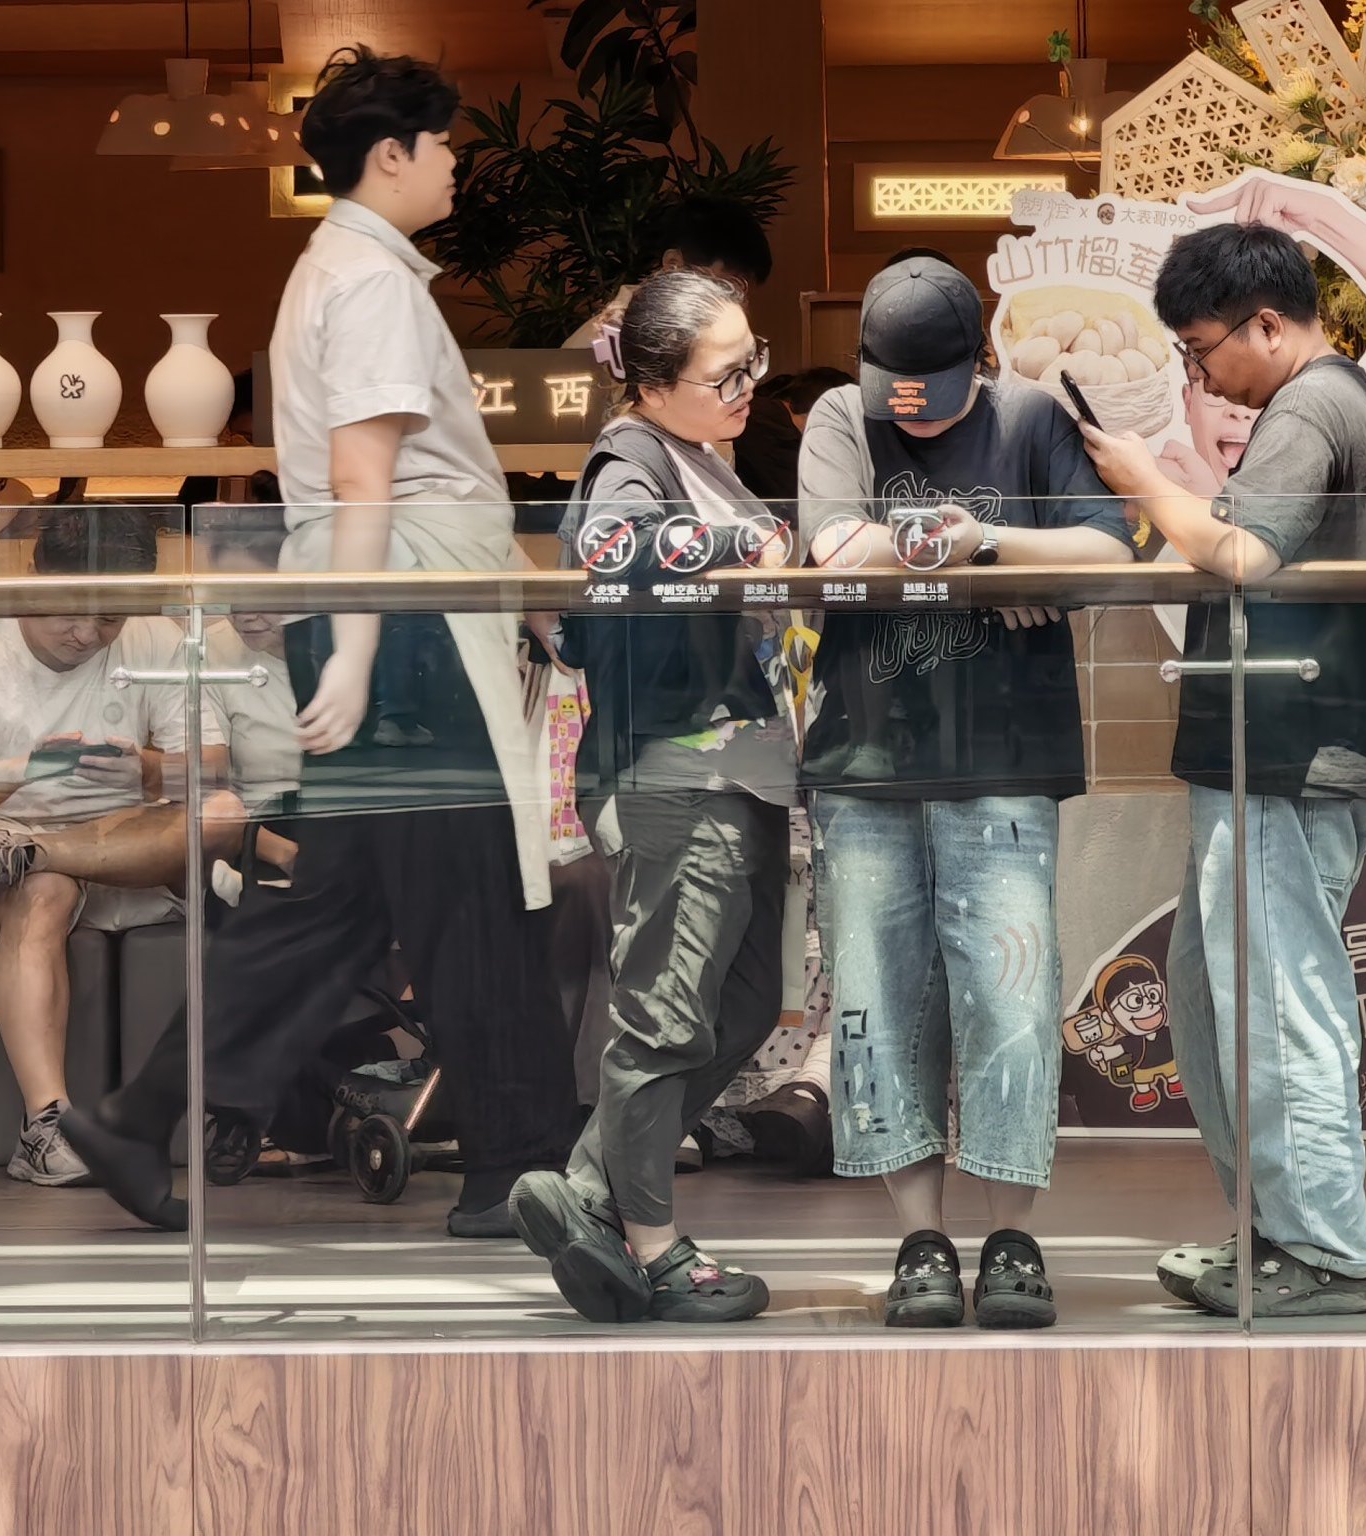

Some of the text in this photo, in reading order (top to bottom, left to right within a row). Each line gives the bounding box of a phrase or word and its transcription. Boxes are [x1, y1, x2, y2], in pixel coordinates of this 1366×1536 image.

[995, 234, 1181, 290] 山竹榴莲
[471, 373, 594, 416] 江西
